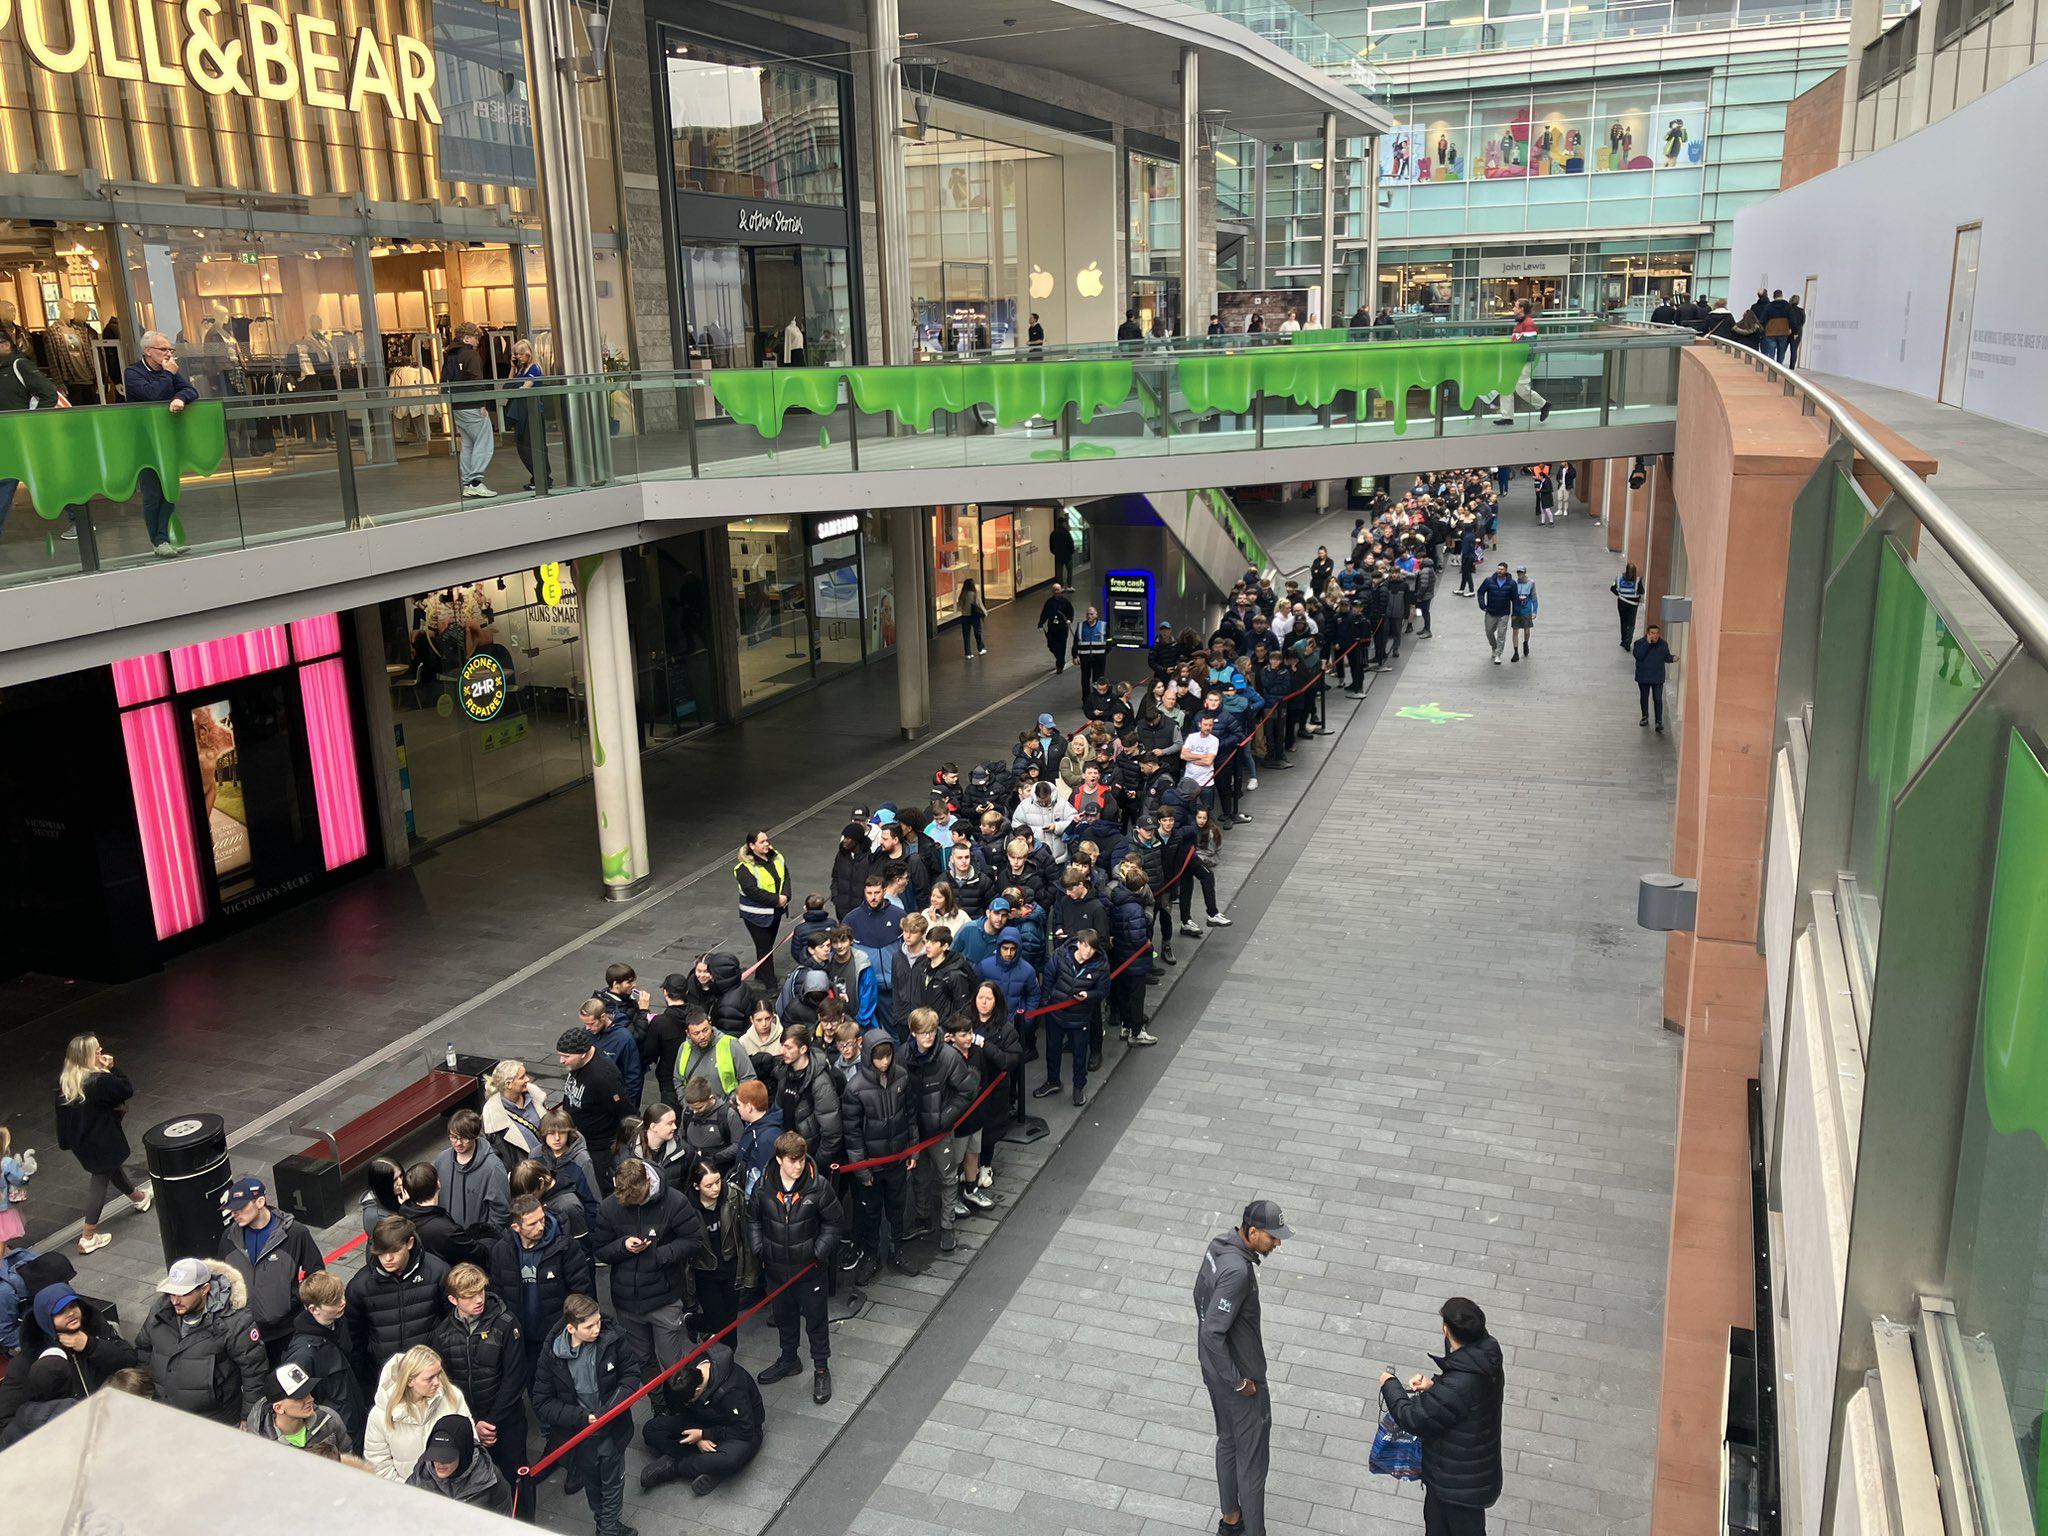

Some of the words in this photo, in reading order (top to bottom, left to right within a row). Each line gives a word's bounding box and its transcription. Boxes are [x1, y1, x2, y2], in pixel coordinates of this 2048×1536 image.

[0, 0, 443, 126] ULL&BEAR
[775, 210, 804, 235] Stories
[1502, 262, 1522, 274] John
[1523, 261, 1546, 271] Lewis
[1110, 577, 1126, 587] free
[1126, 579, 1145, 587] cash
[528, 605, 551, 623] RUNS
[463, 657, 498, 680] PHONES
[471, 678, 495, 698] 2HR
[465, 690, 503, 717] REPAIRED
[223, 887, 281, 916] VICTORIA'S
[293, 1190, 307, 1212] 1
